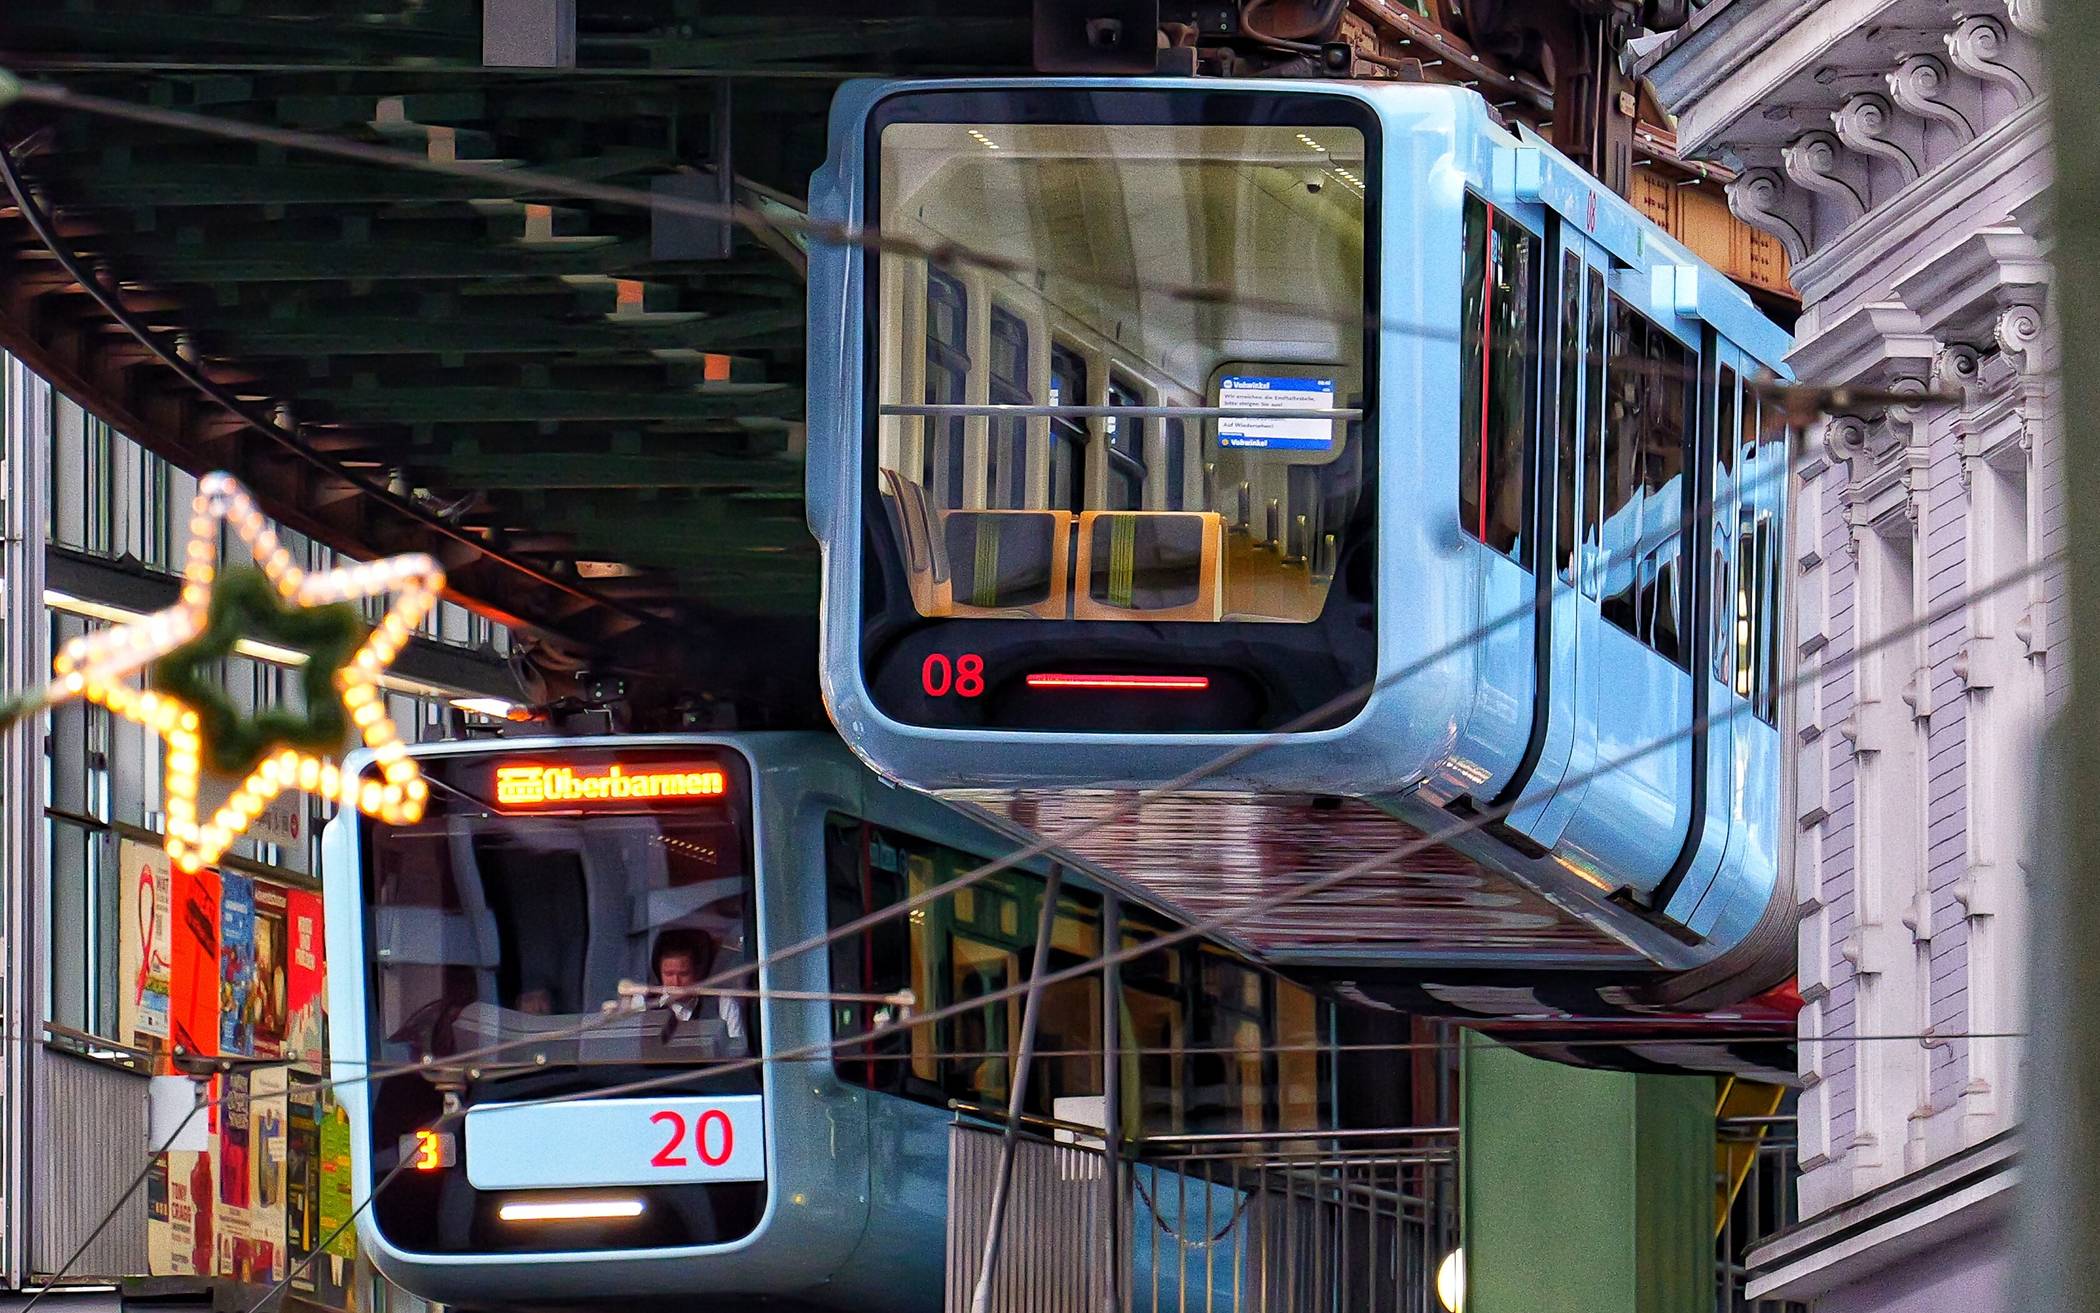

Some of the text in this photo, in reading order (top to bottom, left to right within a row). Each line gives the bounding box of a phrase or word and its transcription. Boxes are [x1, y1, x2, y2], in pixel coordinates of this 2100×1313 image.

[921, 652, 985, 698] 08
[543, 765, 723, 800] Oberbarmen
[415, 1130, 438, 1169] 3
[649, 1109, 735, 1167] 20
